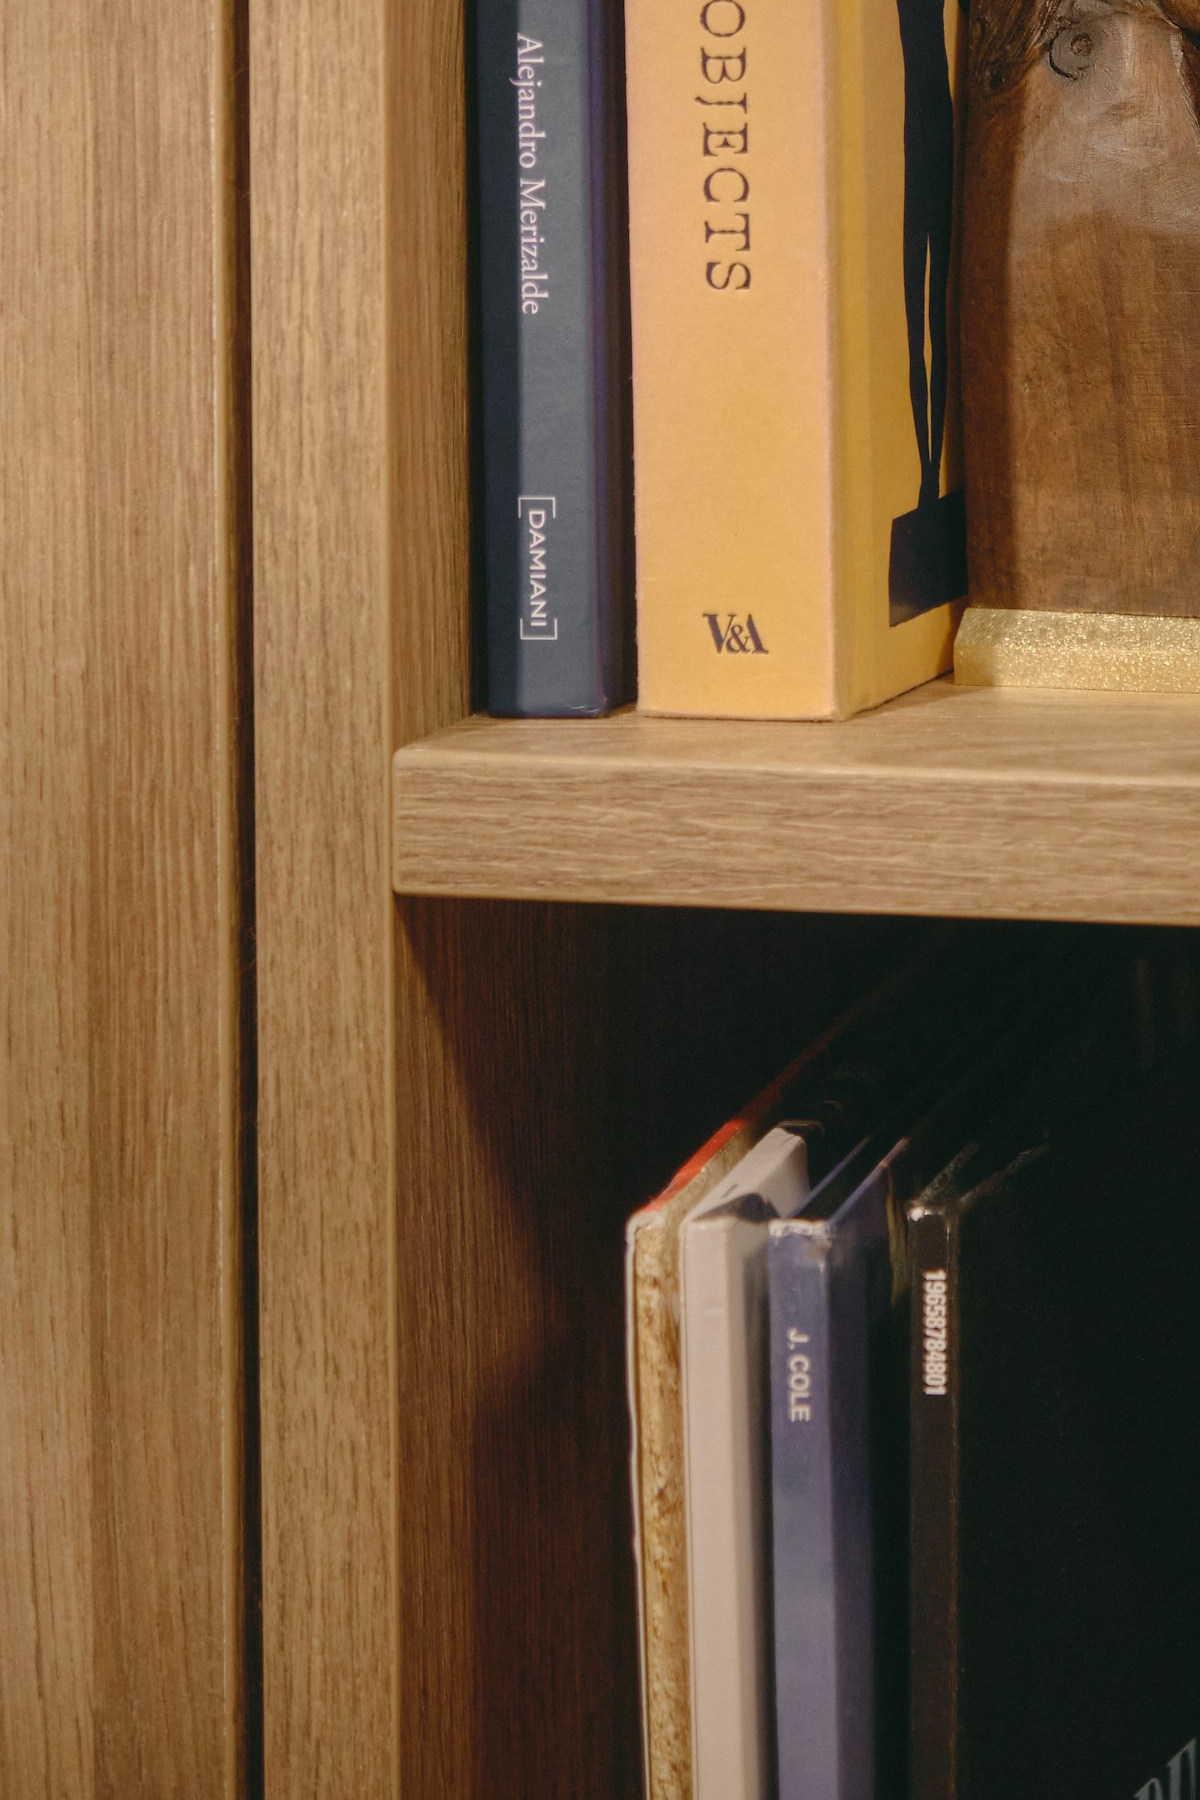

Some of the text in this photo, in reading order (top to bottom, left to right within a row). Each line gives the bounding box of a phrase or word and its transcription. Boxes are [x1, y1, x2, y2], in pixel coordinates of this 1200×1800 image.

[509, 32, 546, 168] Alejandro
[520, 178, 549, 314] Merizalde
[702, 613, 769, 654] V&A
[788, 1327, 811, 1422] J. COLE
